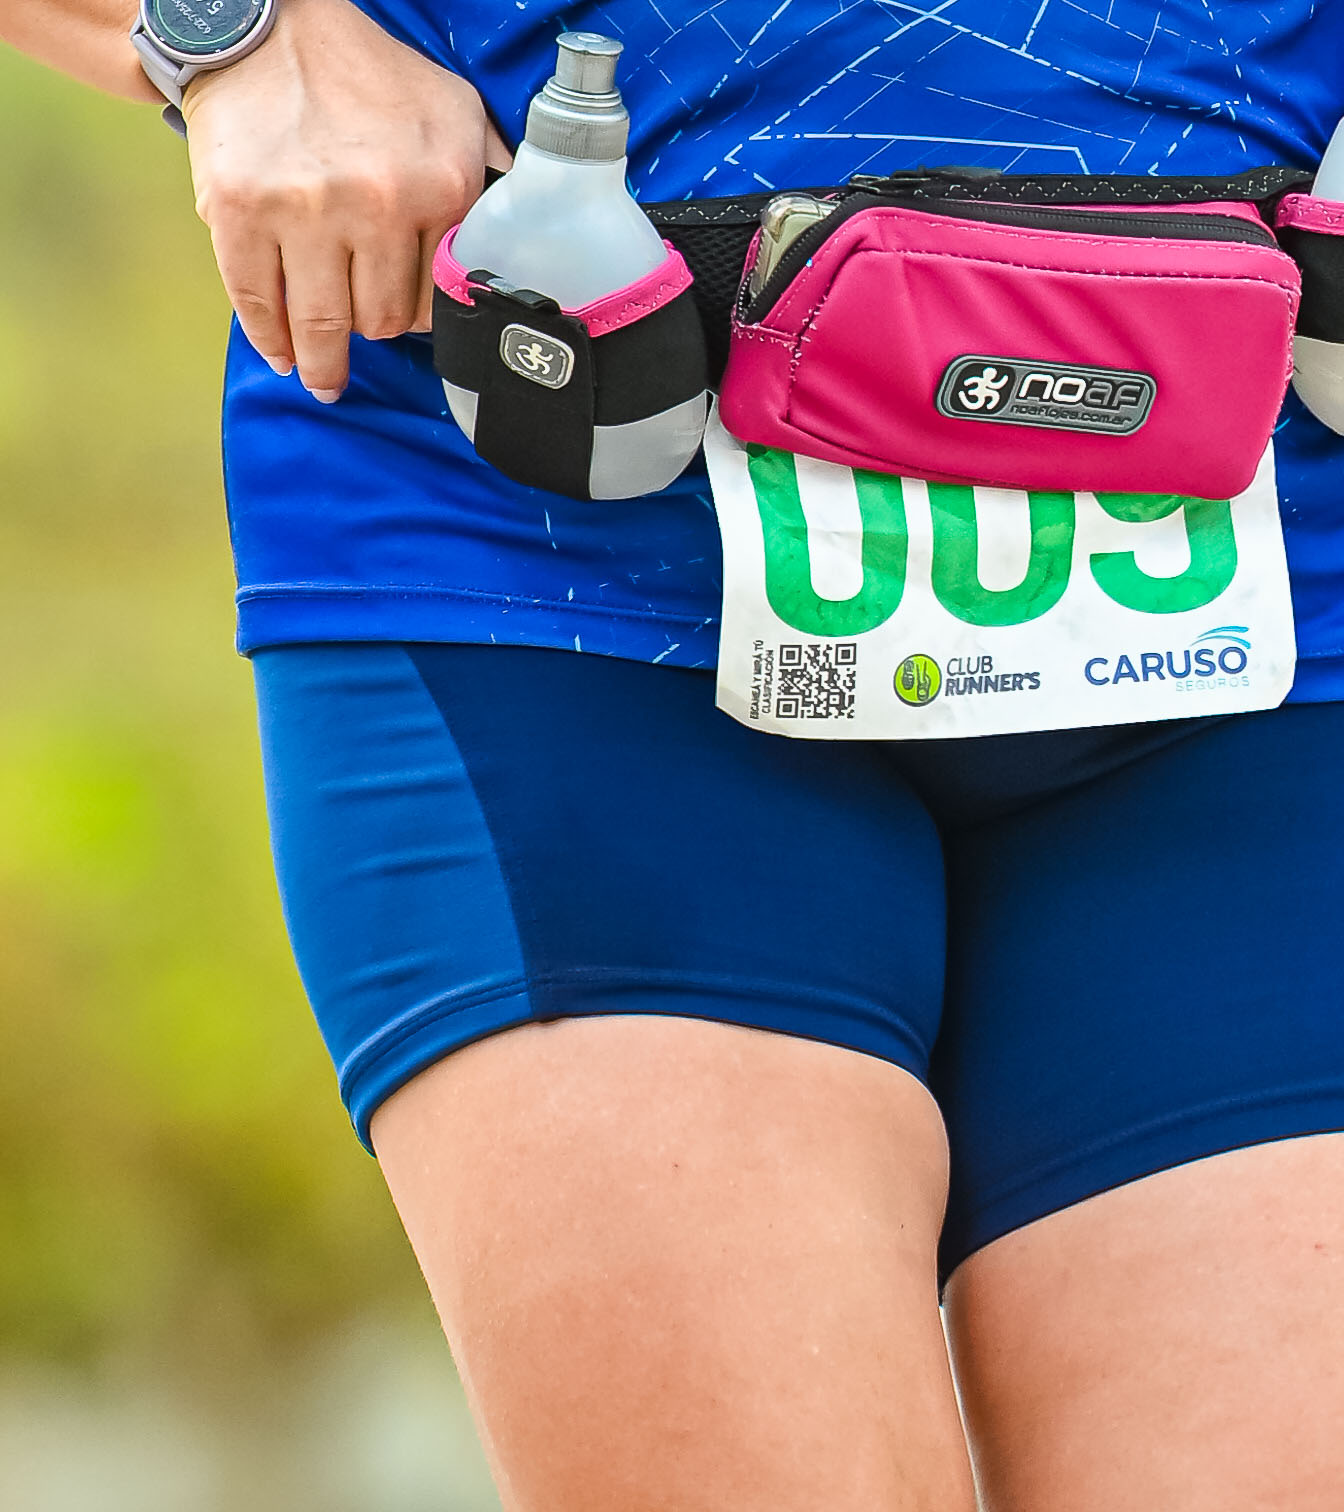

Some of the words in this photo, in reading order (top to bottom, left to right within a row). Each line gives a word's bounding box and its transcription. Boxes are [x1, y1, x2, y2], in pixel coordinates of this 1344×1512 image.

[946, 655, 994, 676] CLUB
[1084, 646, 1248, 686] CARUSO
[944, 671, 1041, 697] RUNNER'S
[1175, 676, 1251, 692] SEGUROS
